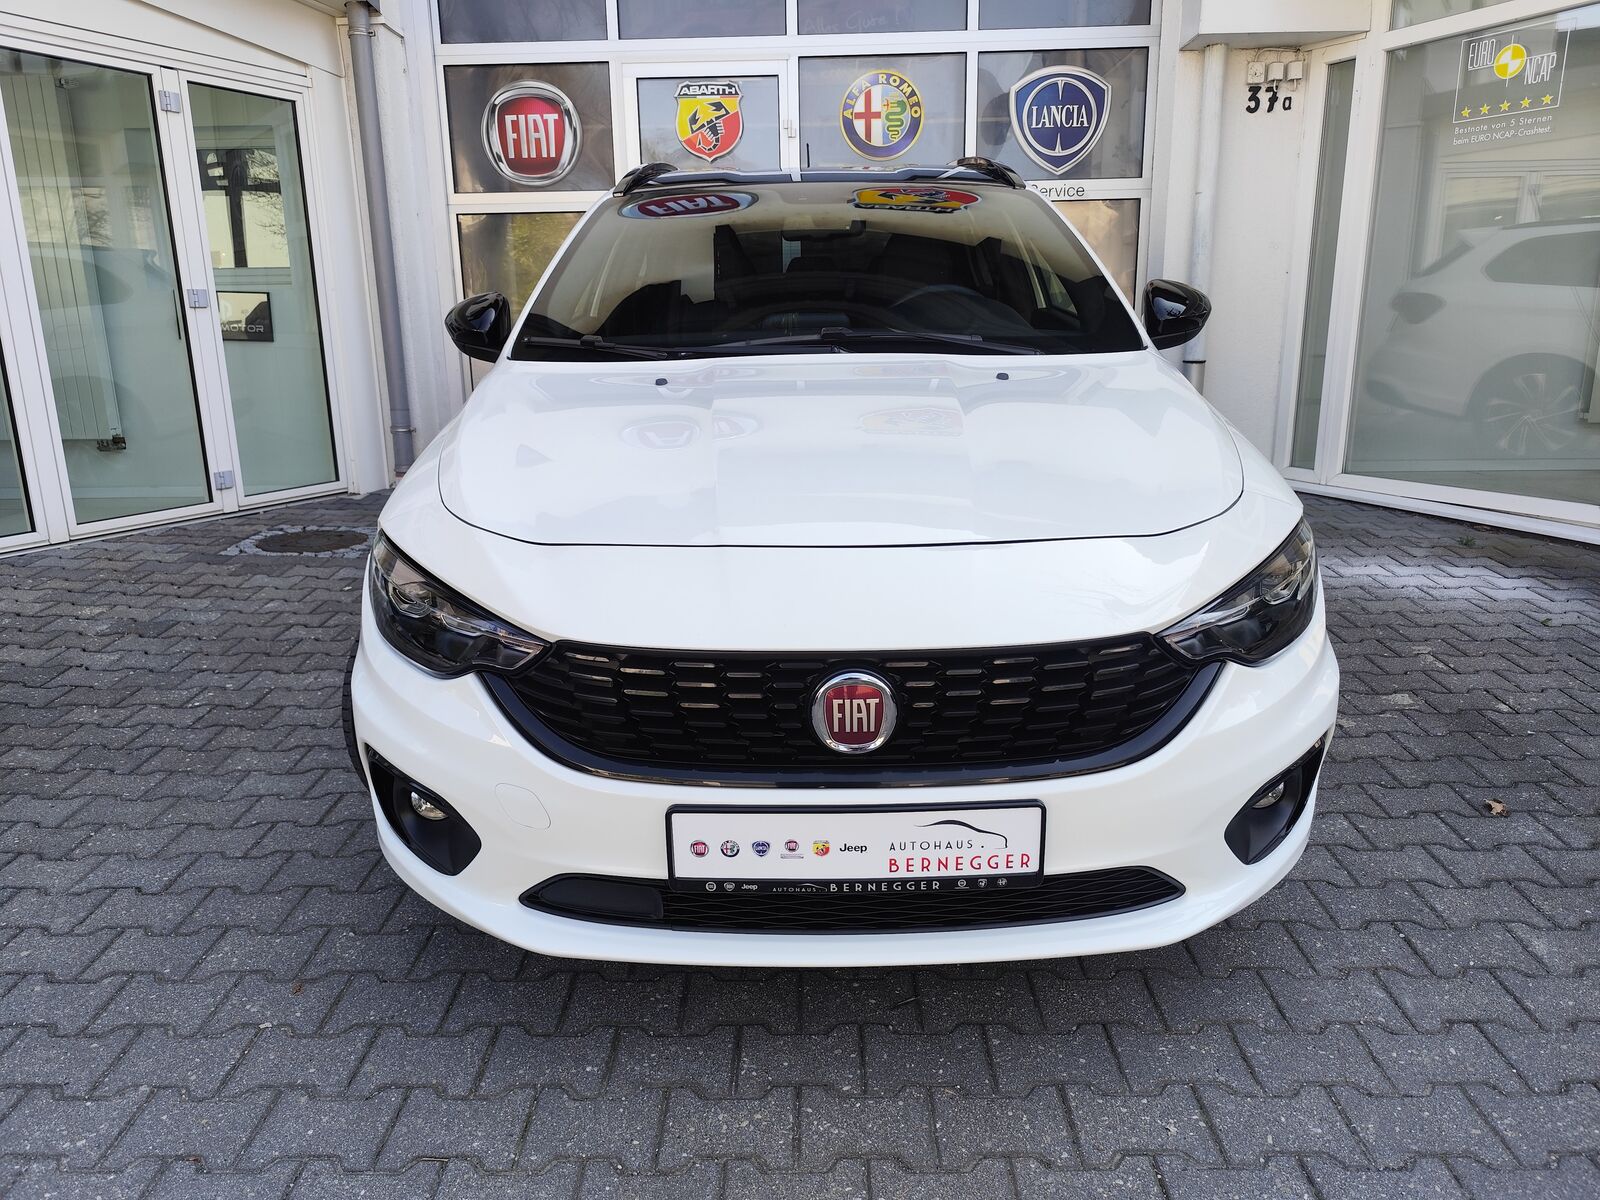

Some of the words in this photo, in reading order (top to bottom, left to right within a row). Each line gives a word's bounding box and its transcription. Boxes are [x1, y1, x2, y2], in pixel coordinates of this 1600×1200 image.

[1467, 39, 1496, 69] EURO
[1523, 53, 1557, 85] NCAP
[680, 85, 735, 95] ABARTH
[843, 79, 872, 120] ALFA
[878, 74, 921, 118] ROMEO
[1245, 85, 1292, 114] 37a
[1030, 104, 1089, 129] LANCIA
[1454, 124, 1488, 135] Bestnote
[1509, 118, 1516, 127] 5
[1519, 115, 1553, 125] Sternen
[504, 113, 559, 159] FIAT
[1452, 138, 1469, 146] beim
[1470, 133, 1491, 143] EURO
[832, 698, 880, 733] FIAT
[839, 843, 868, 854] Jeep
[888, 853, 1031, 873] BERNEGGER
[830, 881, 940, 892] BERNEGGER
